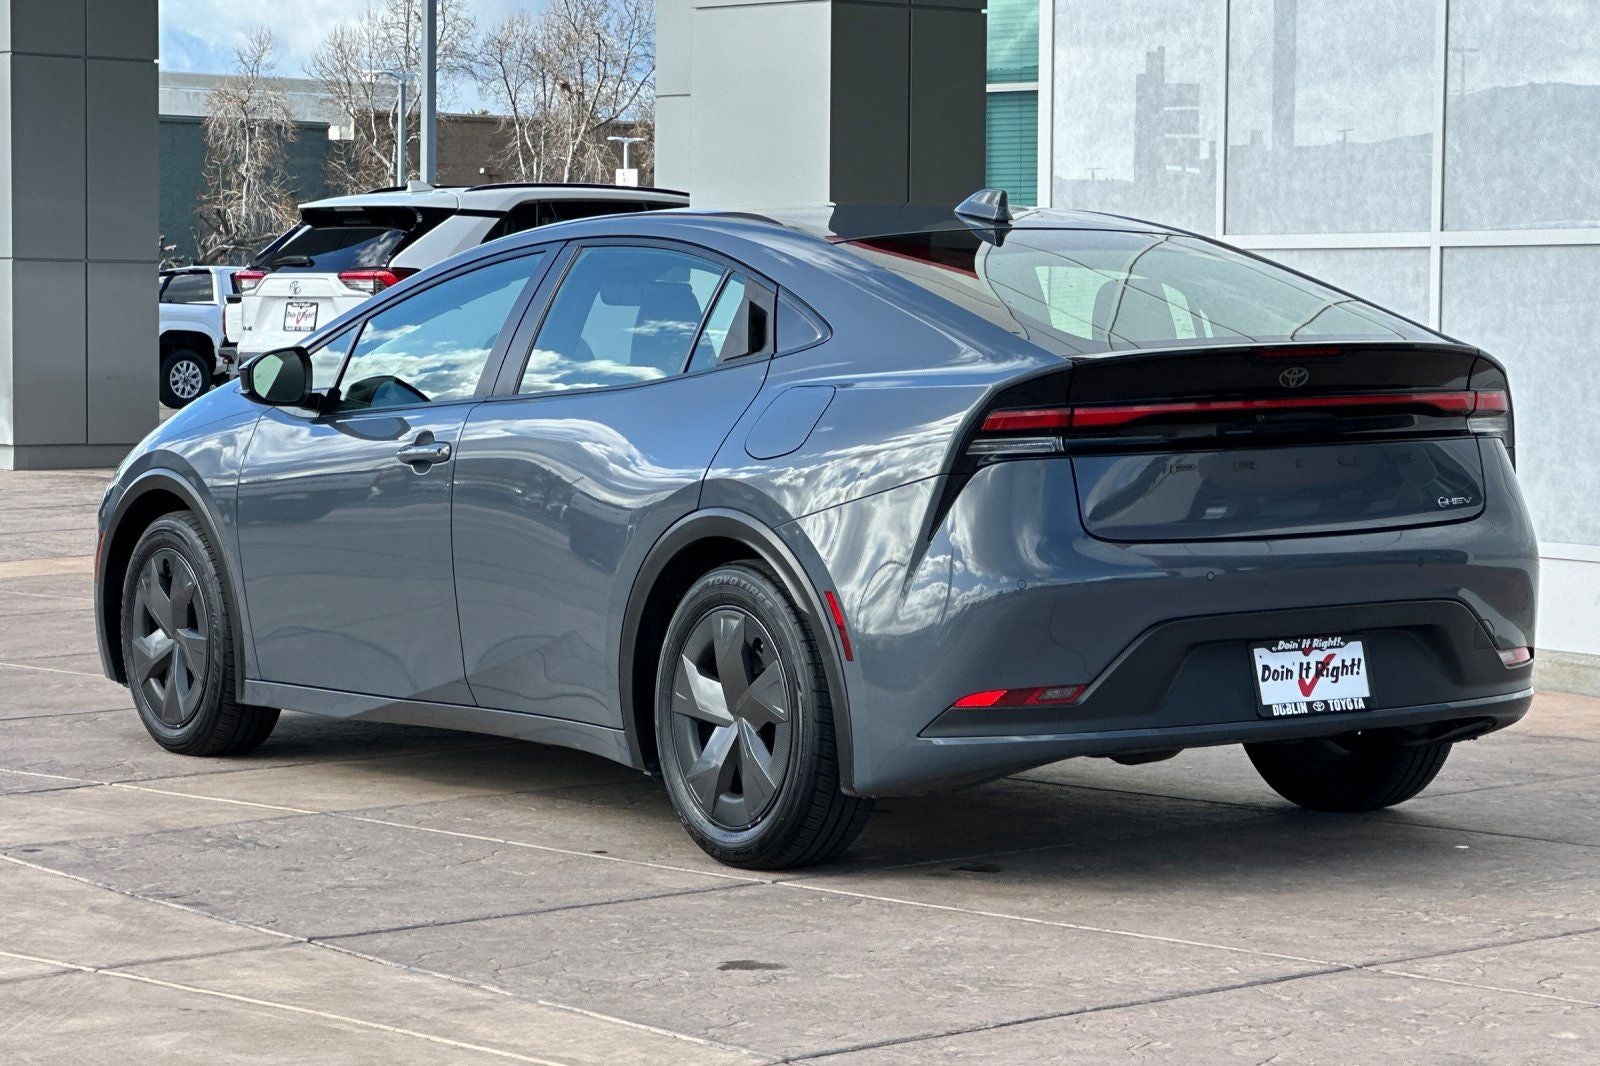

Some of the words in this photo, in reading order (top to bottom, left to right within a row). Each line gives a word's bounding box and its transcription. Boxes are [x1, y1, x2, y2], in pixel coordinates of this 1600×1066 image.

[708, 576, 739, 587] TOYO
[738, 579, 773, 609] TIRES
[1301, 638, 1311, 649] It
[1312, 636, 1342, 651] Right!
[1298, 661, 1312, 679] It
[1315, 658, 1362, 683] Right!
[1272, 702, 1308, 716] DUBLIN
[1328, 697, 1366, 712] TOYOTA
